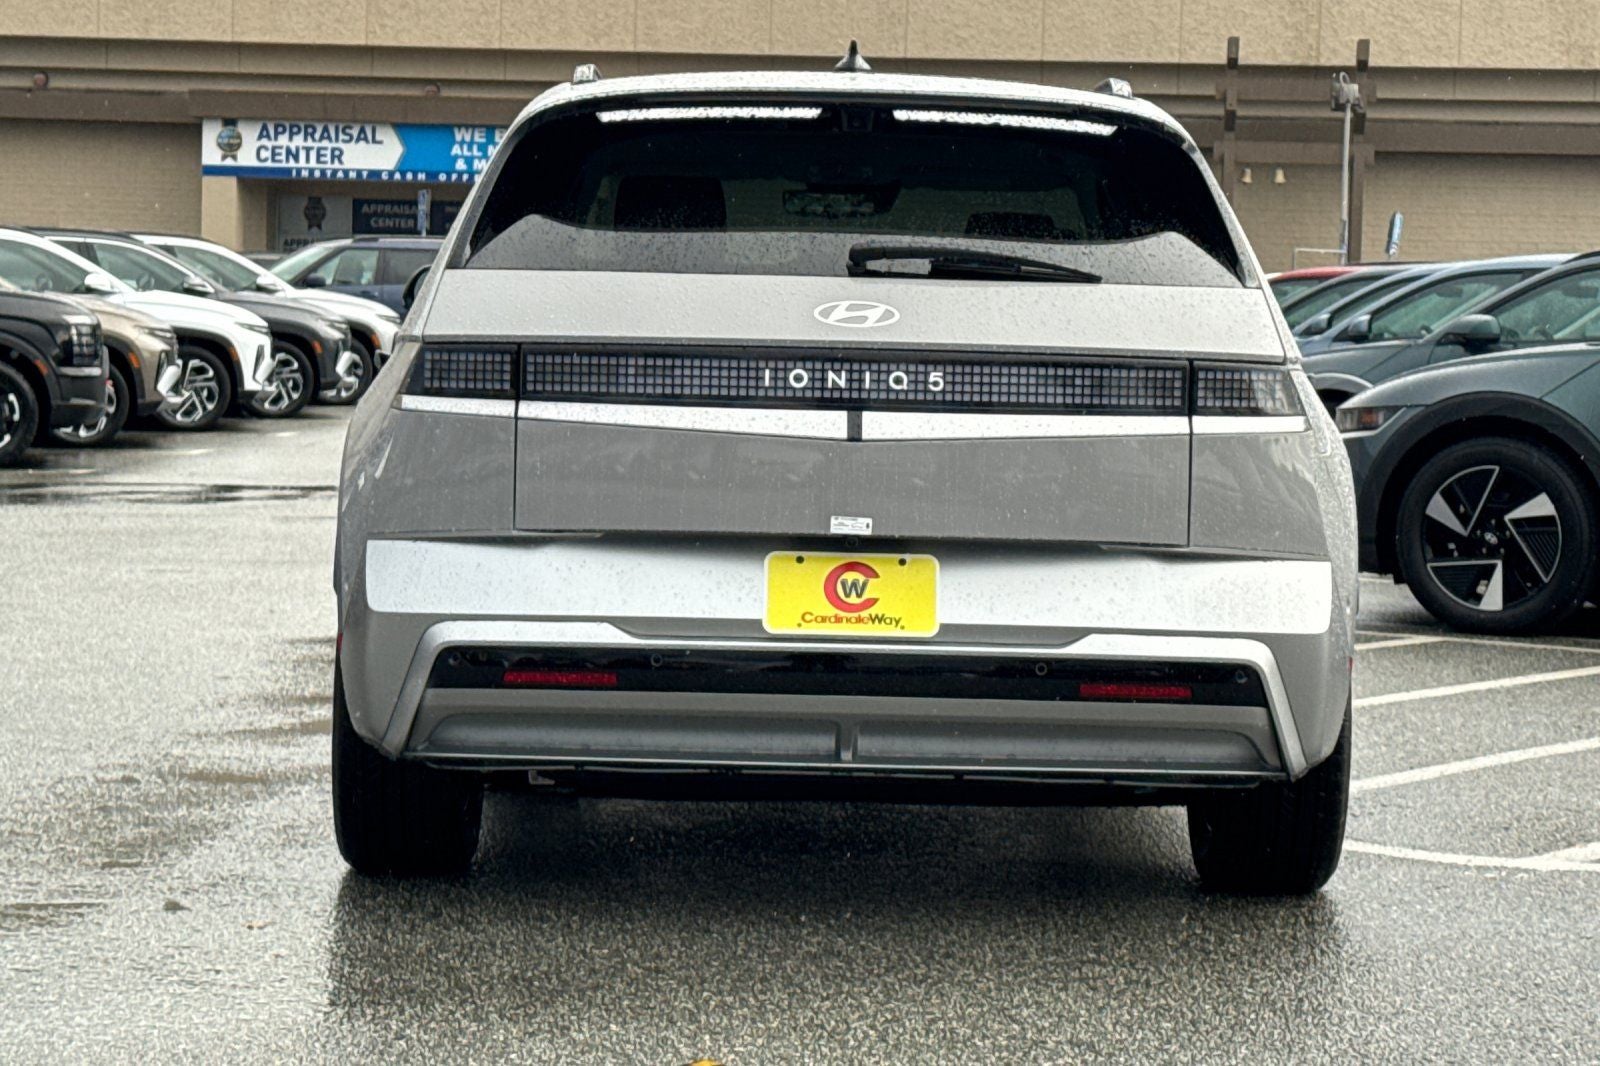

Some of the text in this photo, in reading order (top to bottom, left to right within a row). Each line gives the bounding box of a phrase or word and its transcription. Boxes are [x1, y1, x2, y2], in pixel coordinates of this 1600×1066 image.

[256, 122, 384, 144] APPRAISAL
[453, 126, 487, 142] WE
[256, 144, 345, 165] CENTER
[450, 143, 483, 156] ALL
[454, 158, 468, 170] &
[291, 168, 369, 179] INSTANT
[381, 170, 427, 181] CASH
[361, 203, 419, 215] APPRAISA
[370, 217, 415, 228] CENTER
[764, 368, 945, 392] IONIQ 5
[801, 611, 902, 627] CardinaleWay
